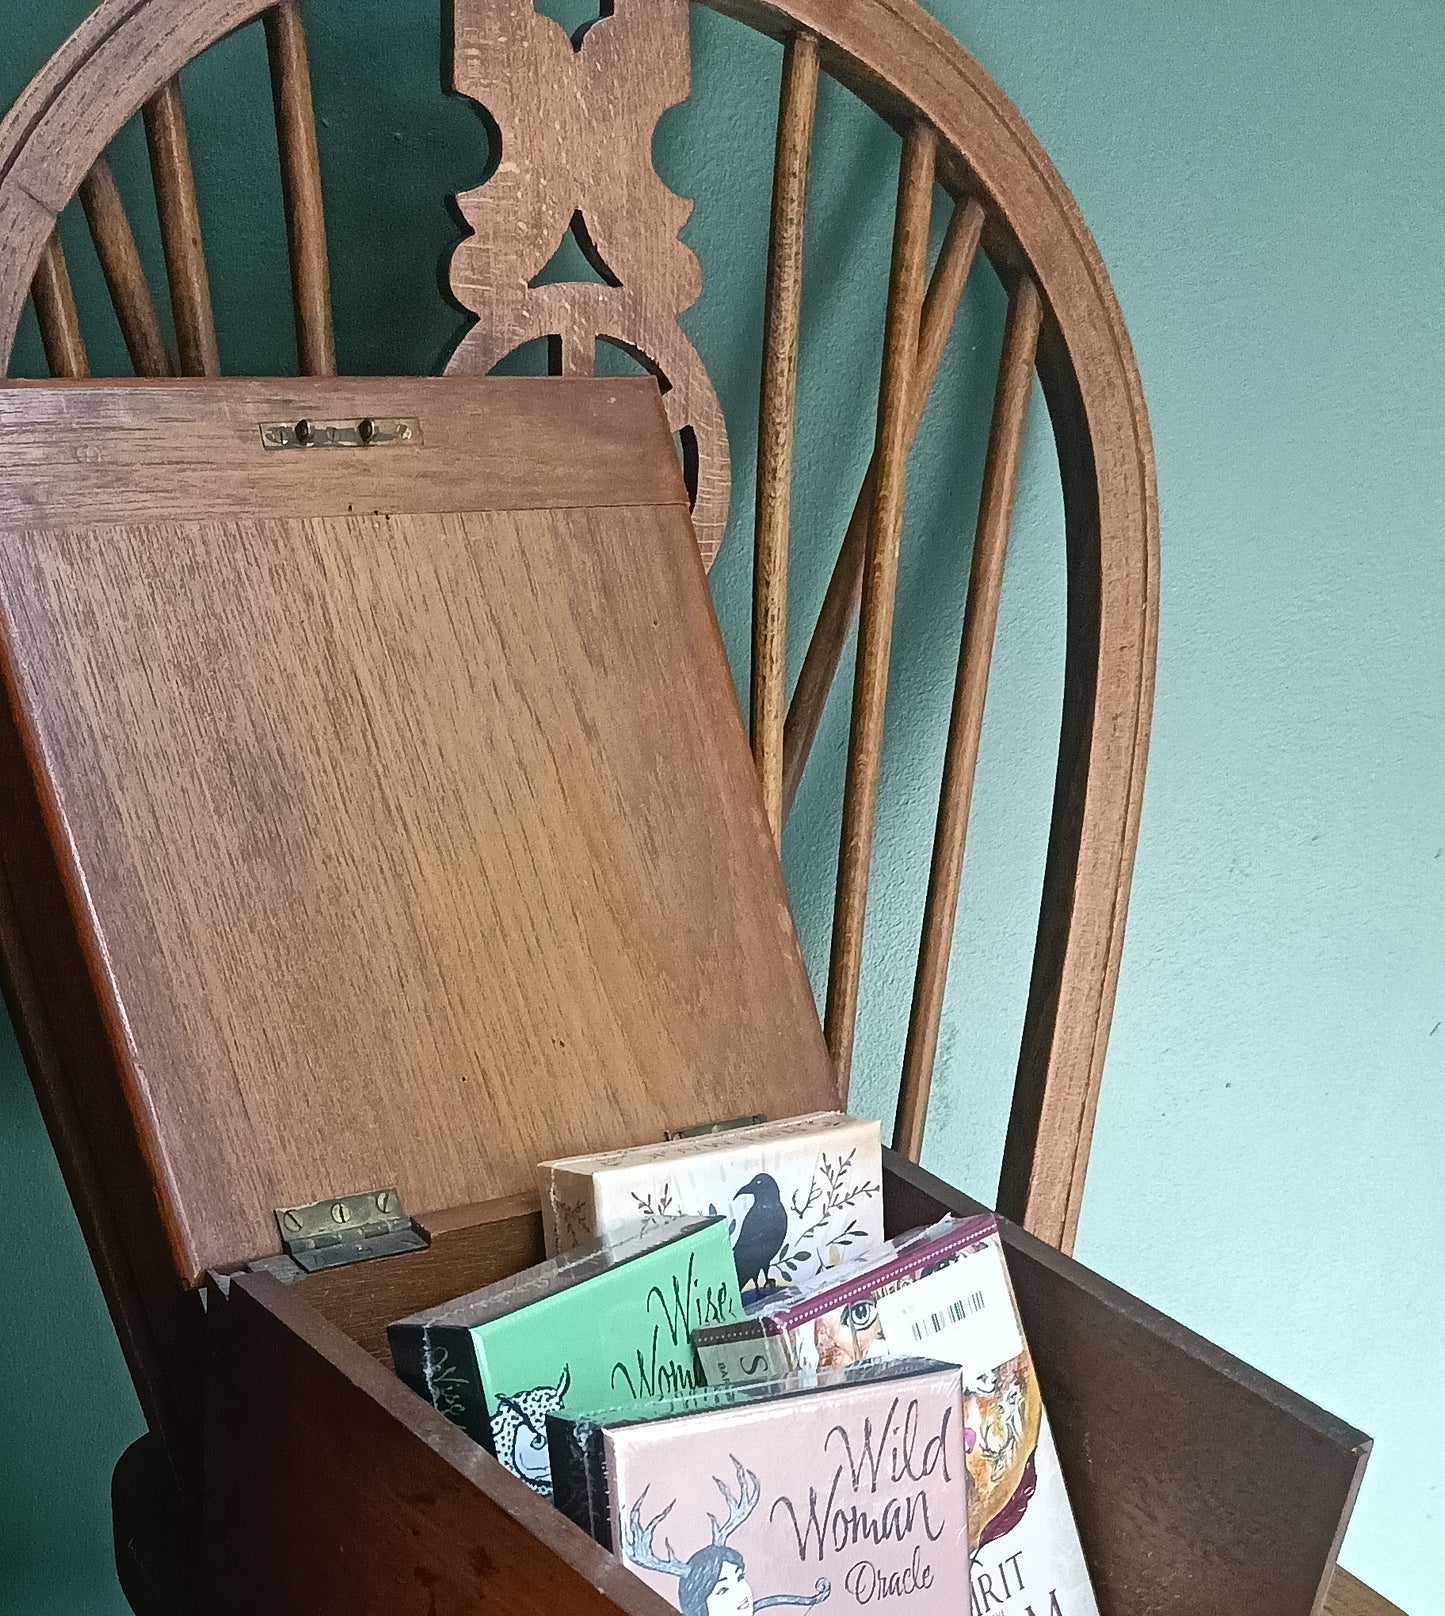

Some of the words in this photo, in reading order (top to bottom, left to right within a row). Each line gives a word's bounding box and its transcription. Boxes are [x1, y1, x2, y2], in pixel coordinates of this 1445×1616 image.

[611, 1325, 697, 1401] Wom
[824, 1397, 952, 1493] Wild
[770, 1465, 945, 1561] Woman
[845, 1545, 934, 1605] Oracle
[971, 1551, 1025, 1616] IRIT
